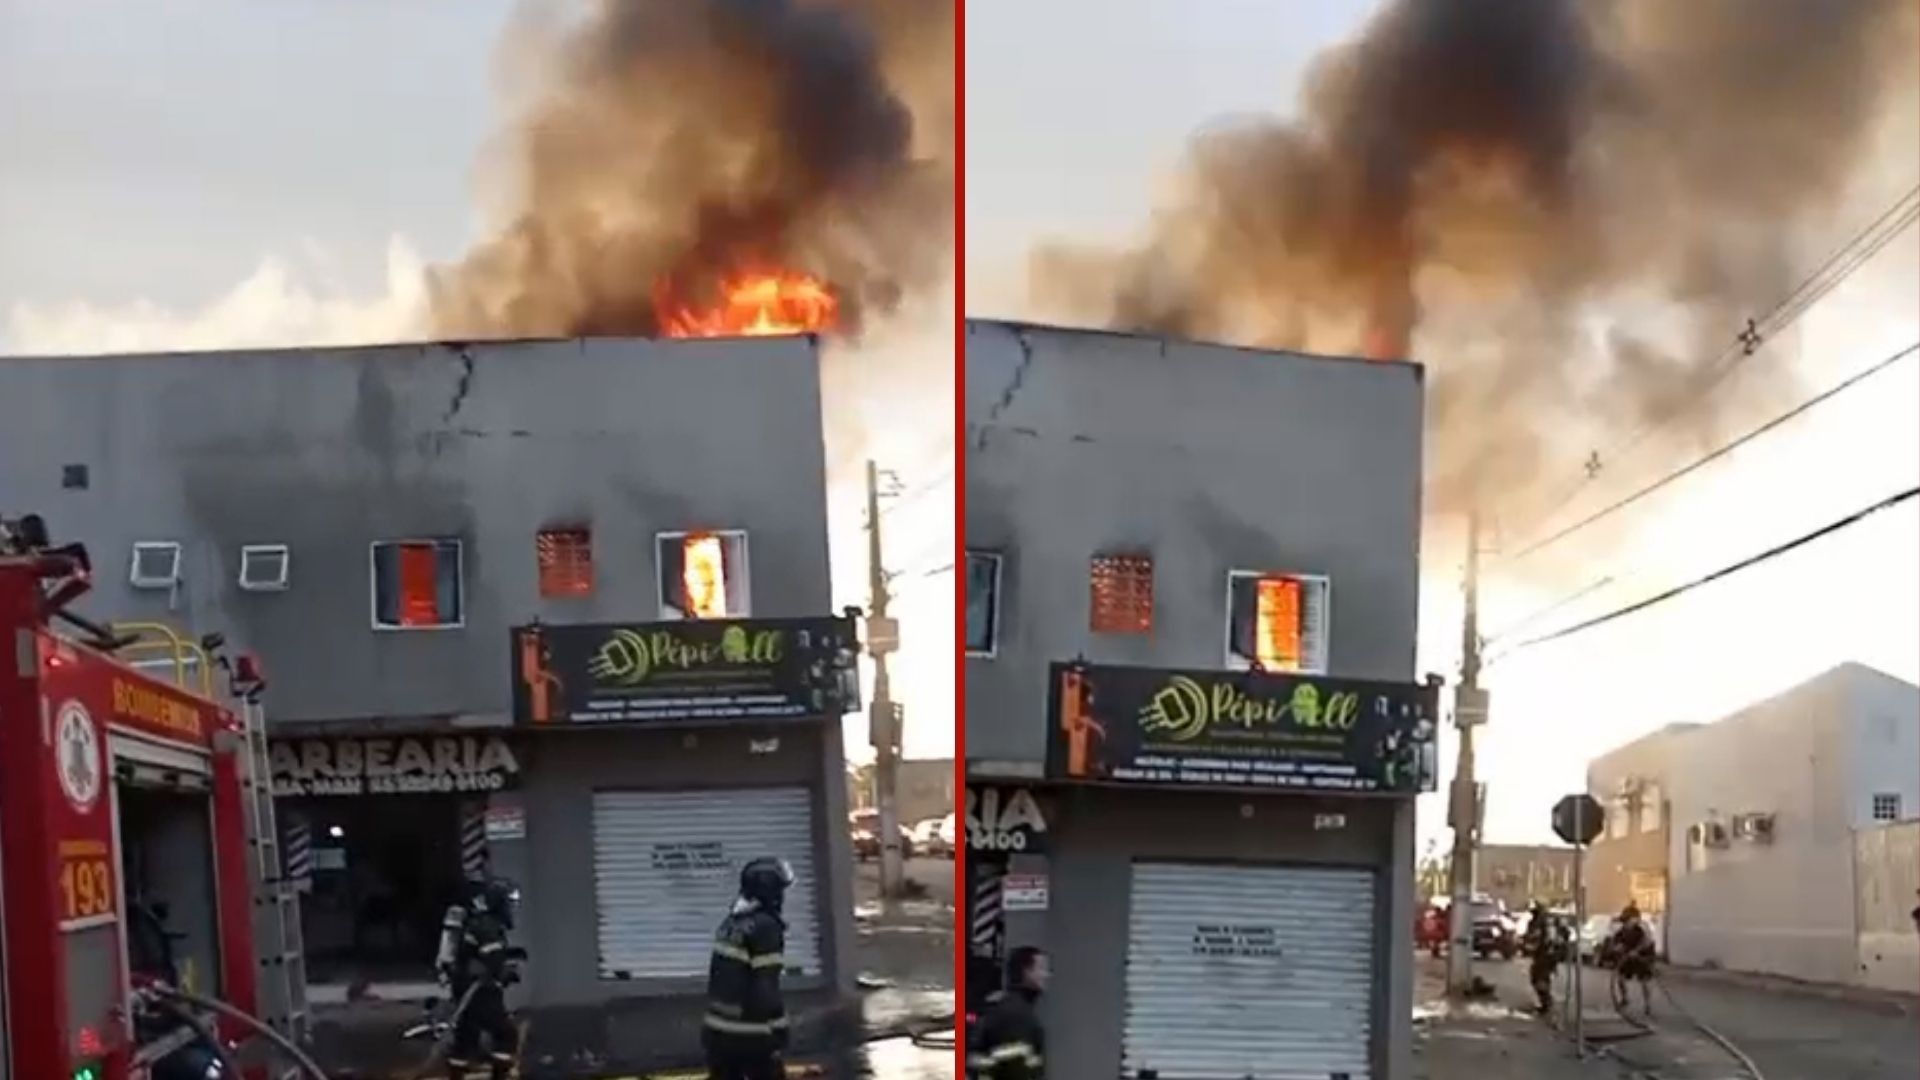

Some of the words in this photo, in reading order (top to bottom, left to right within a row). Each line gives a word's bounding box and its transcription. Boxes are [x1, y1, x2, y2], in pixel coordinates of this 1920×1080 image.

[1212, 682, 1284, 728] Pépi
[271, 737, 520, 780] ARBEARIA
[59, 861, 110, 917] 193
